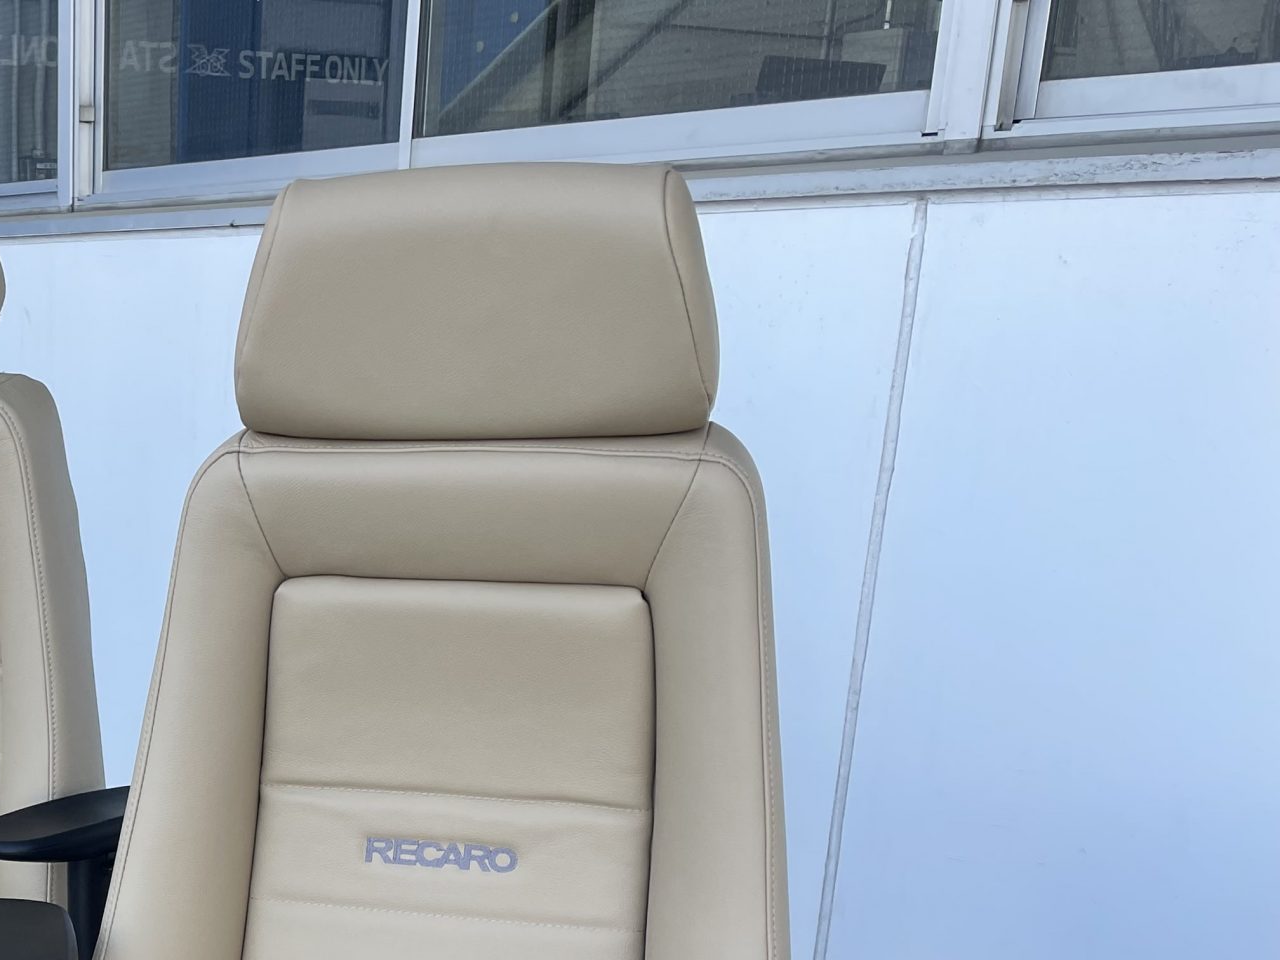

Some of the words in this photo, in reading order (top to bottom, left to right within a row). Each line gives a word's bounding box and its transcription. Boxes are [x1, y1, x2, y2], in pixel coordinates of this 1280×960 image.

[238, 50, 320, 82] STAFF
[325, 55, 389, 86] ONLY
[364, 836, 519, 873] RECARO
